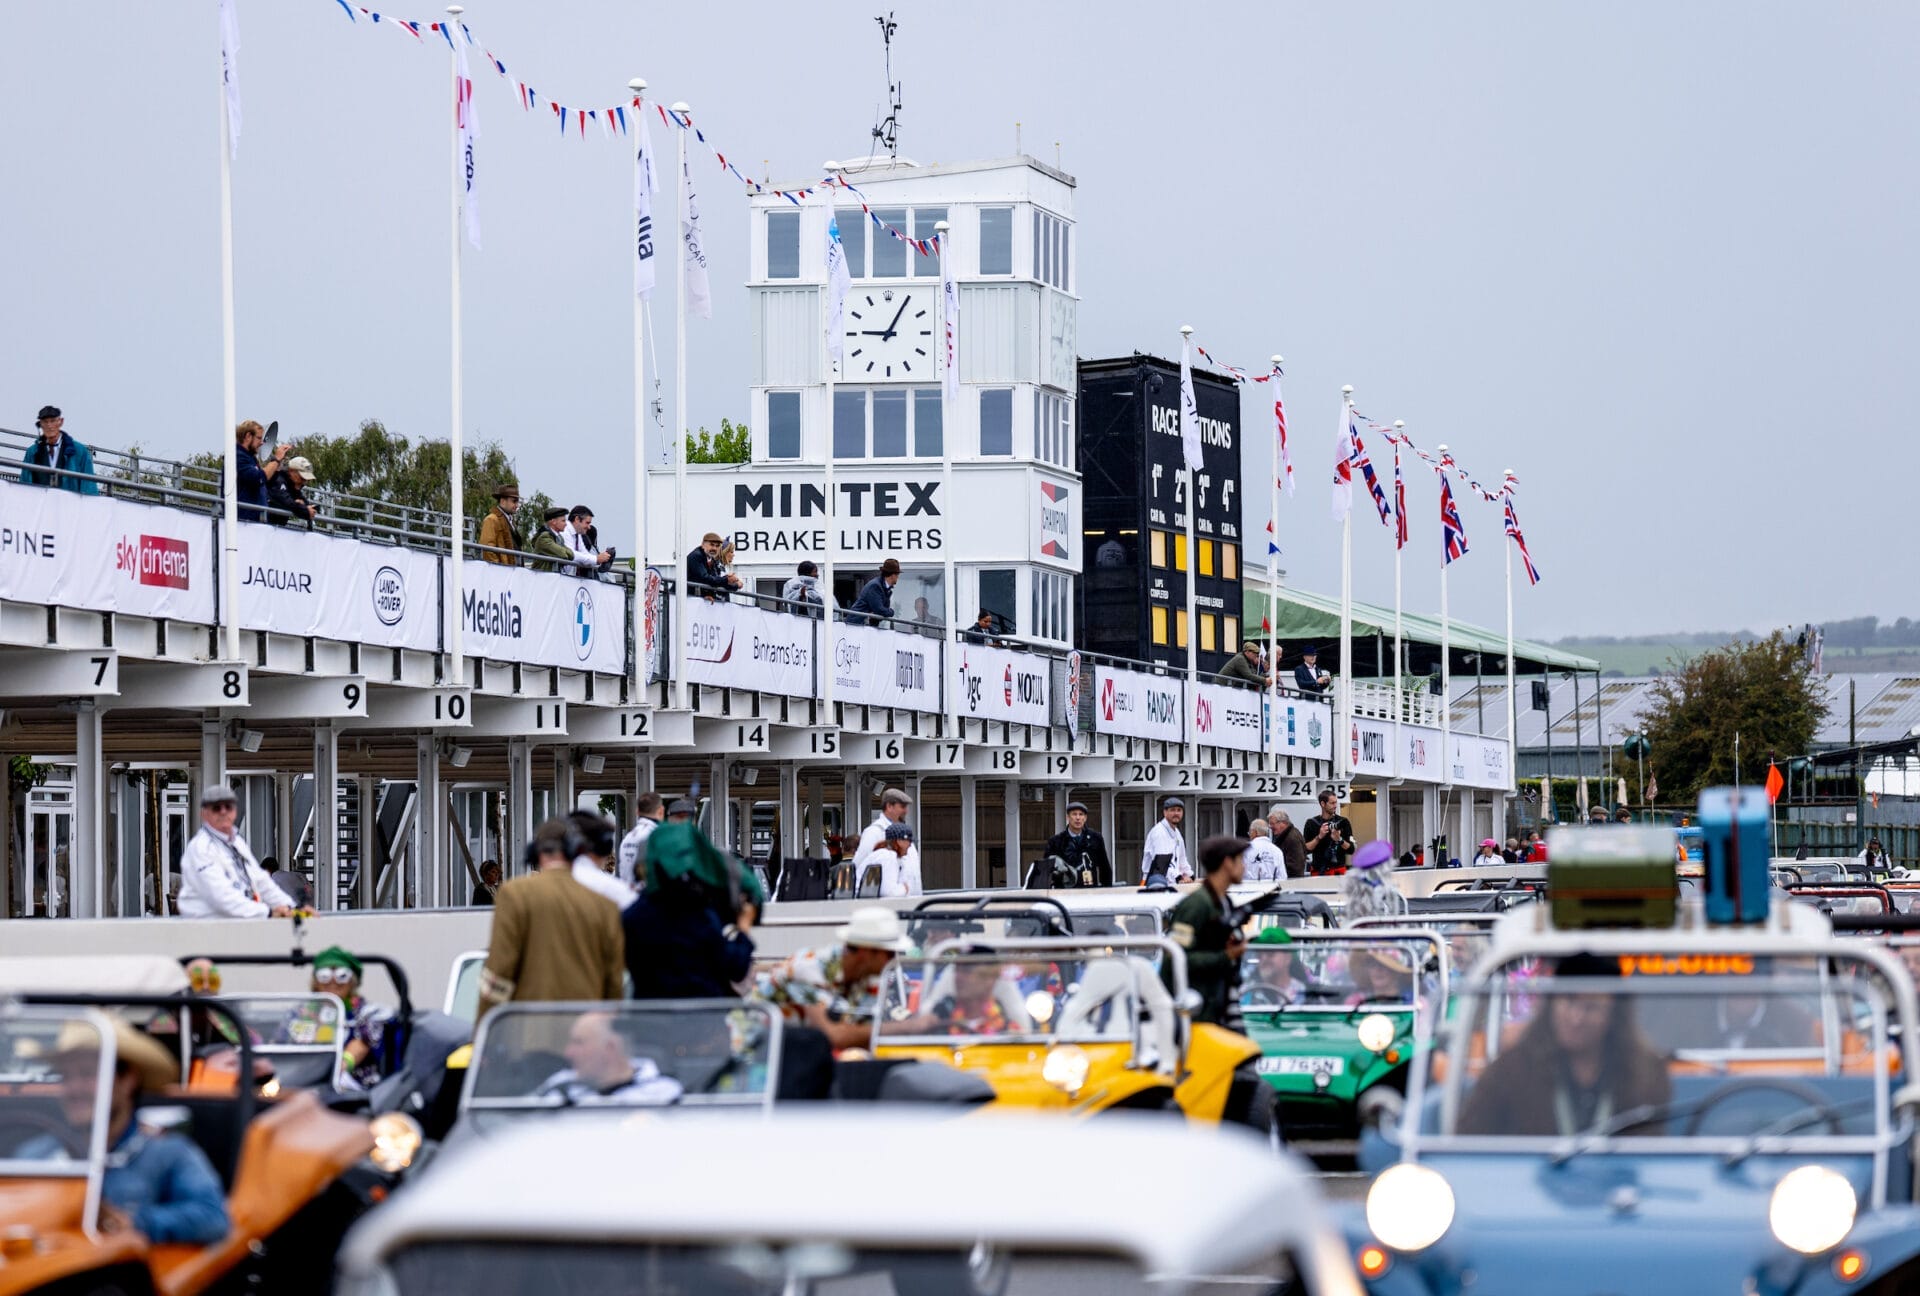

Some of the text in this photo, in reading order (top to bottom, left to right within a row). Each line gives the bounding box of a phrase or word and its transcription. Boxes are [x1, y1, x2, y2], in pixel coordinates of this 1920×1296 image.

[1152, 405, 1178, 436] RACE
[734, 482, 941, 518] MINTEX
[735, 528, 942, 551] BRAKE LINERS
[116, 535, 187, 580] sky cinema
[242, 565, 312, 594] JAGUAR
[462, 588, 522, 638] Medallia
[91, 657, 109, 687] 7
[223, 670, 241, 698] 8
[343, 683, 361, 710] 9
[435, 694, 465, 720] 10
[536, 704, 561, 729] 11
[620, 712, 648, 737] 12
[1196, 693, 1212, 733] AON
[738, 725, 764, 747] 14
[811, 733, 836, 754] 15
[1362, 731, 1385, 764] MOTUL
[875, 739, 899, 759] 16
[936, 744, 959, 763] 17
[993, 750, 1016, 769] 18
[1047, 756, 1068, 774] 19
[1133, 764, 1156, 782] 20
[1178, 770, 1199, 787] 21
[1216, 773, 1239, 789] 22
[1256, 777, 1278, 793] 23
[1290, 781, 1312, 796] 24
